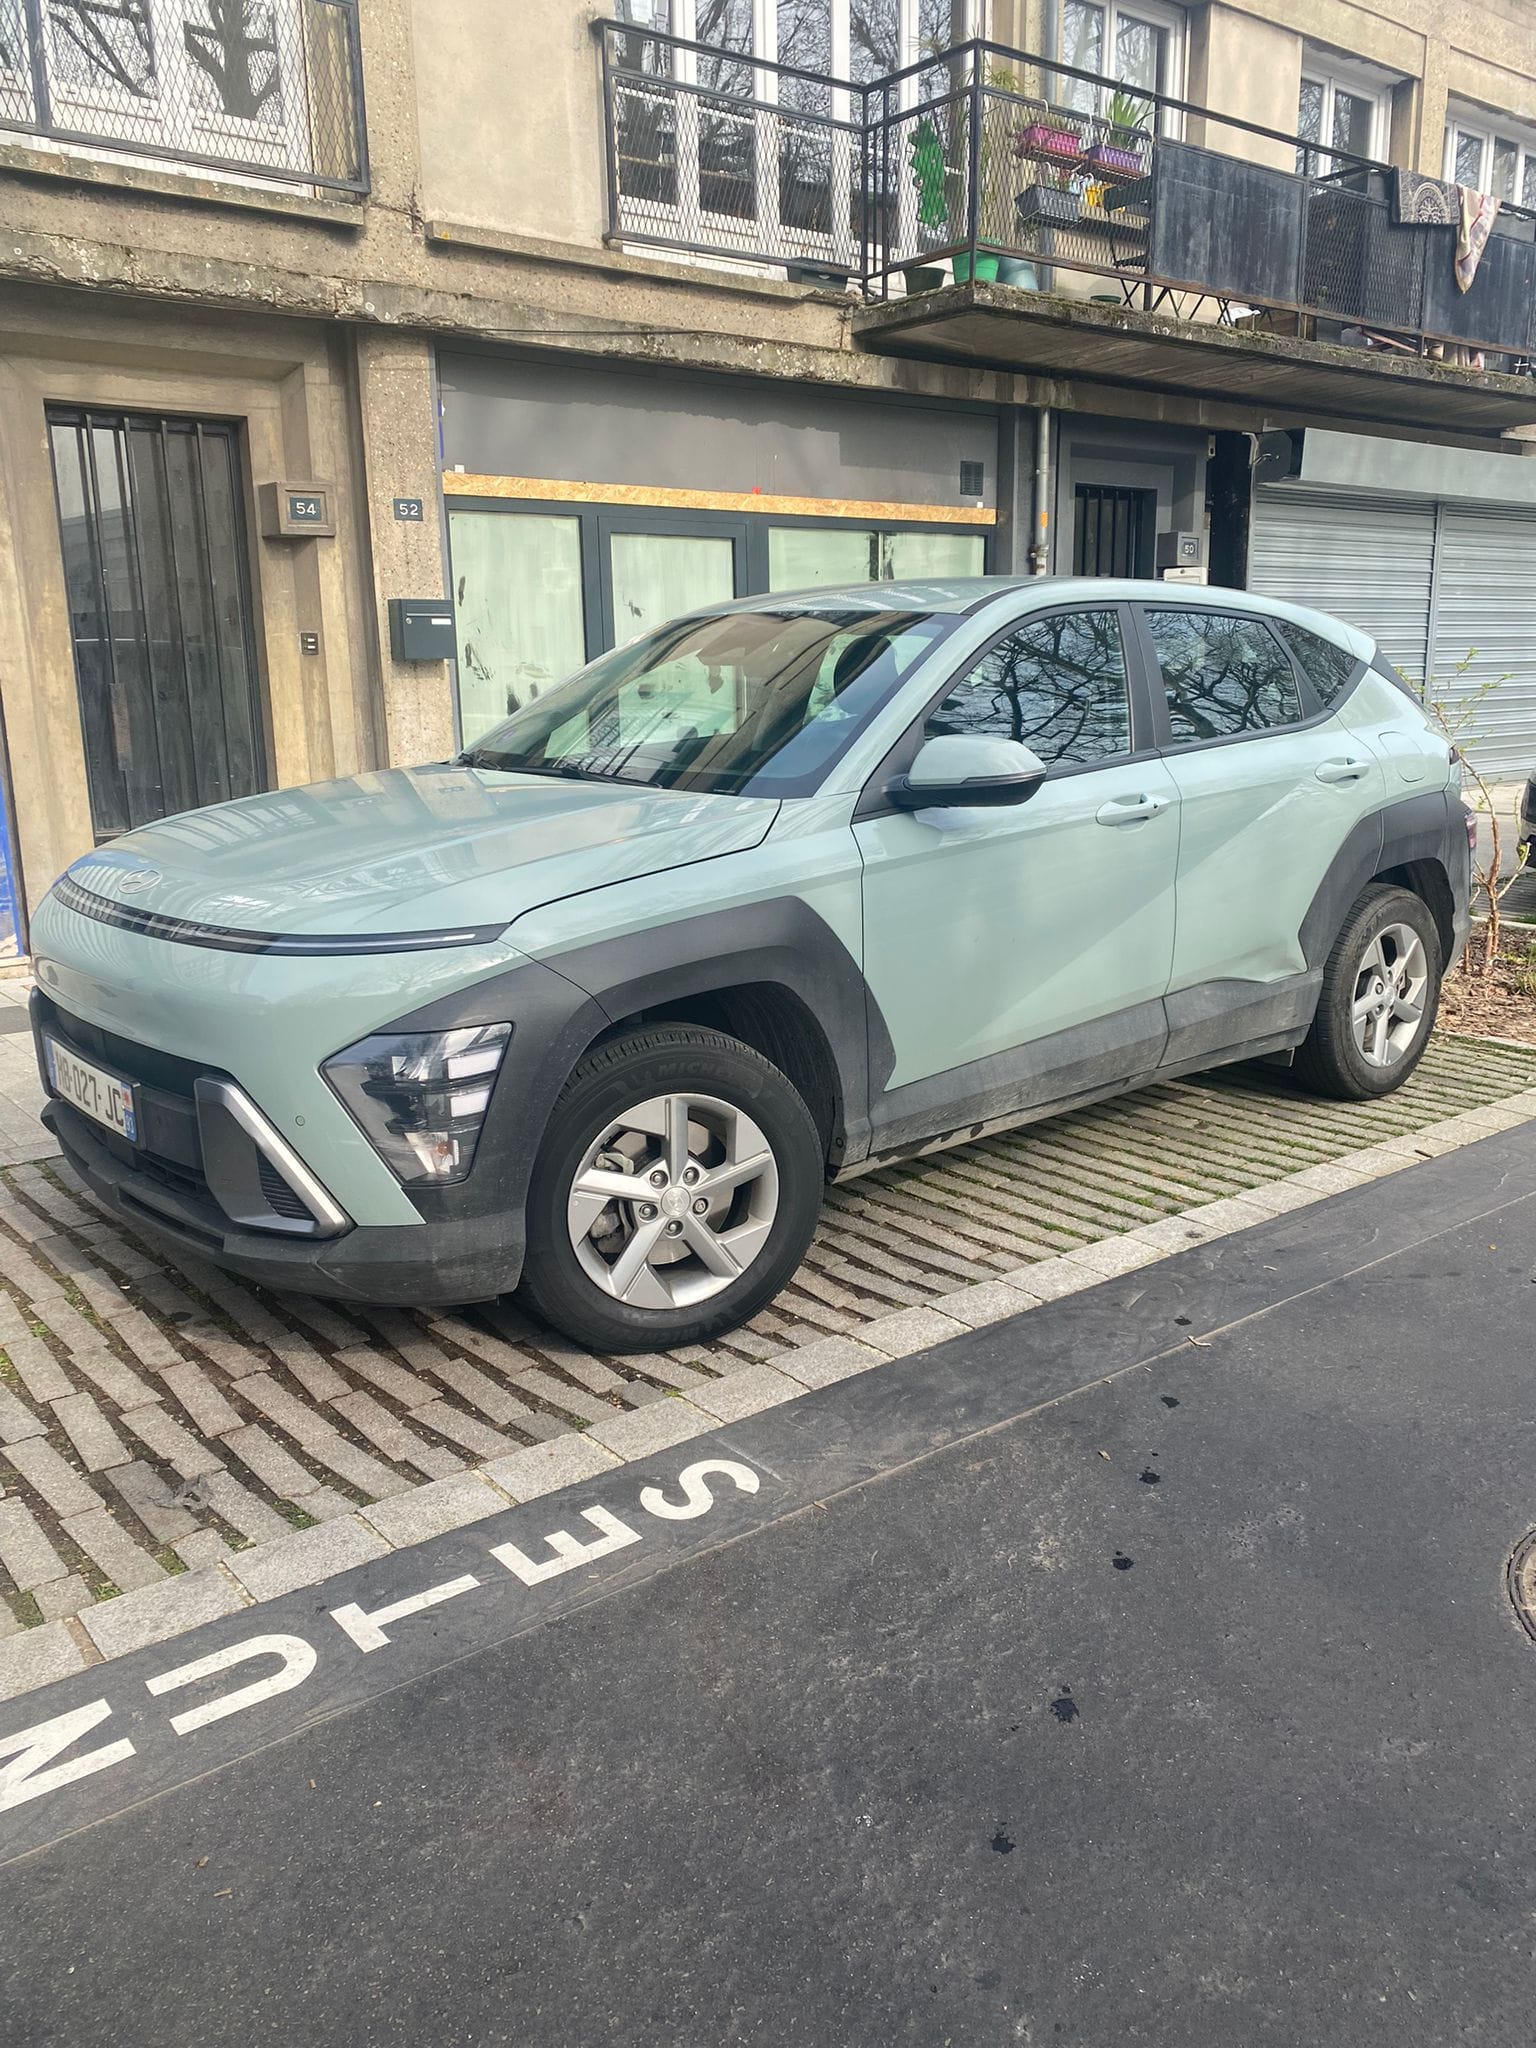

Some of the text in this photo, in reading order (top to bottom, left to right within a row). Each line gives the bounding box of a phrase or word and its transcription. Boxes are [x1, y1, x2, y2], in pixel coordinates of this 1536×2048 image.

[296, 502, 317, 515] 54
[399, 503, 419, 516] 52
[1184, 544, 1195, 554] 50
